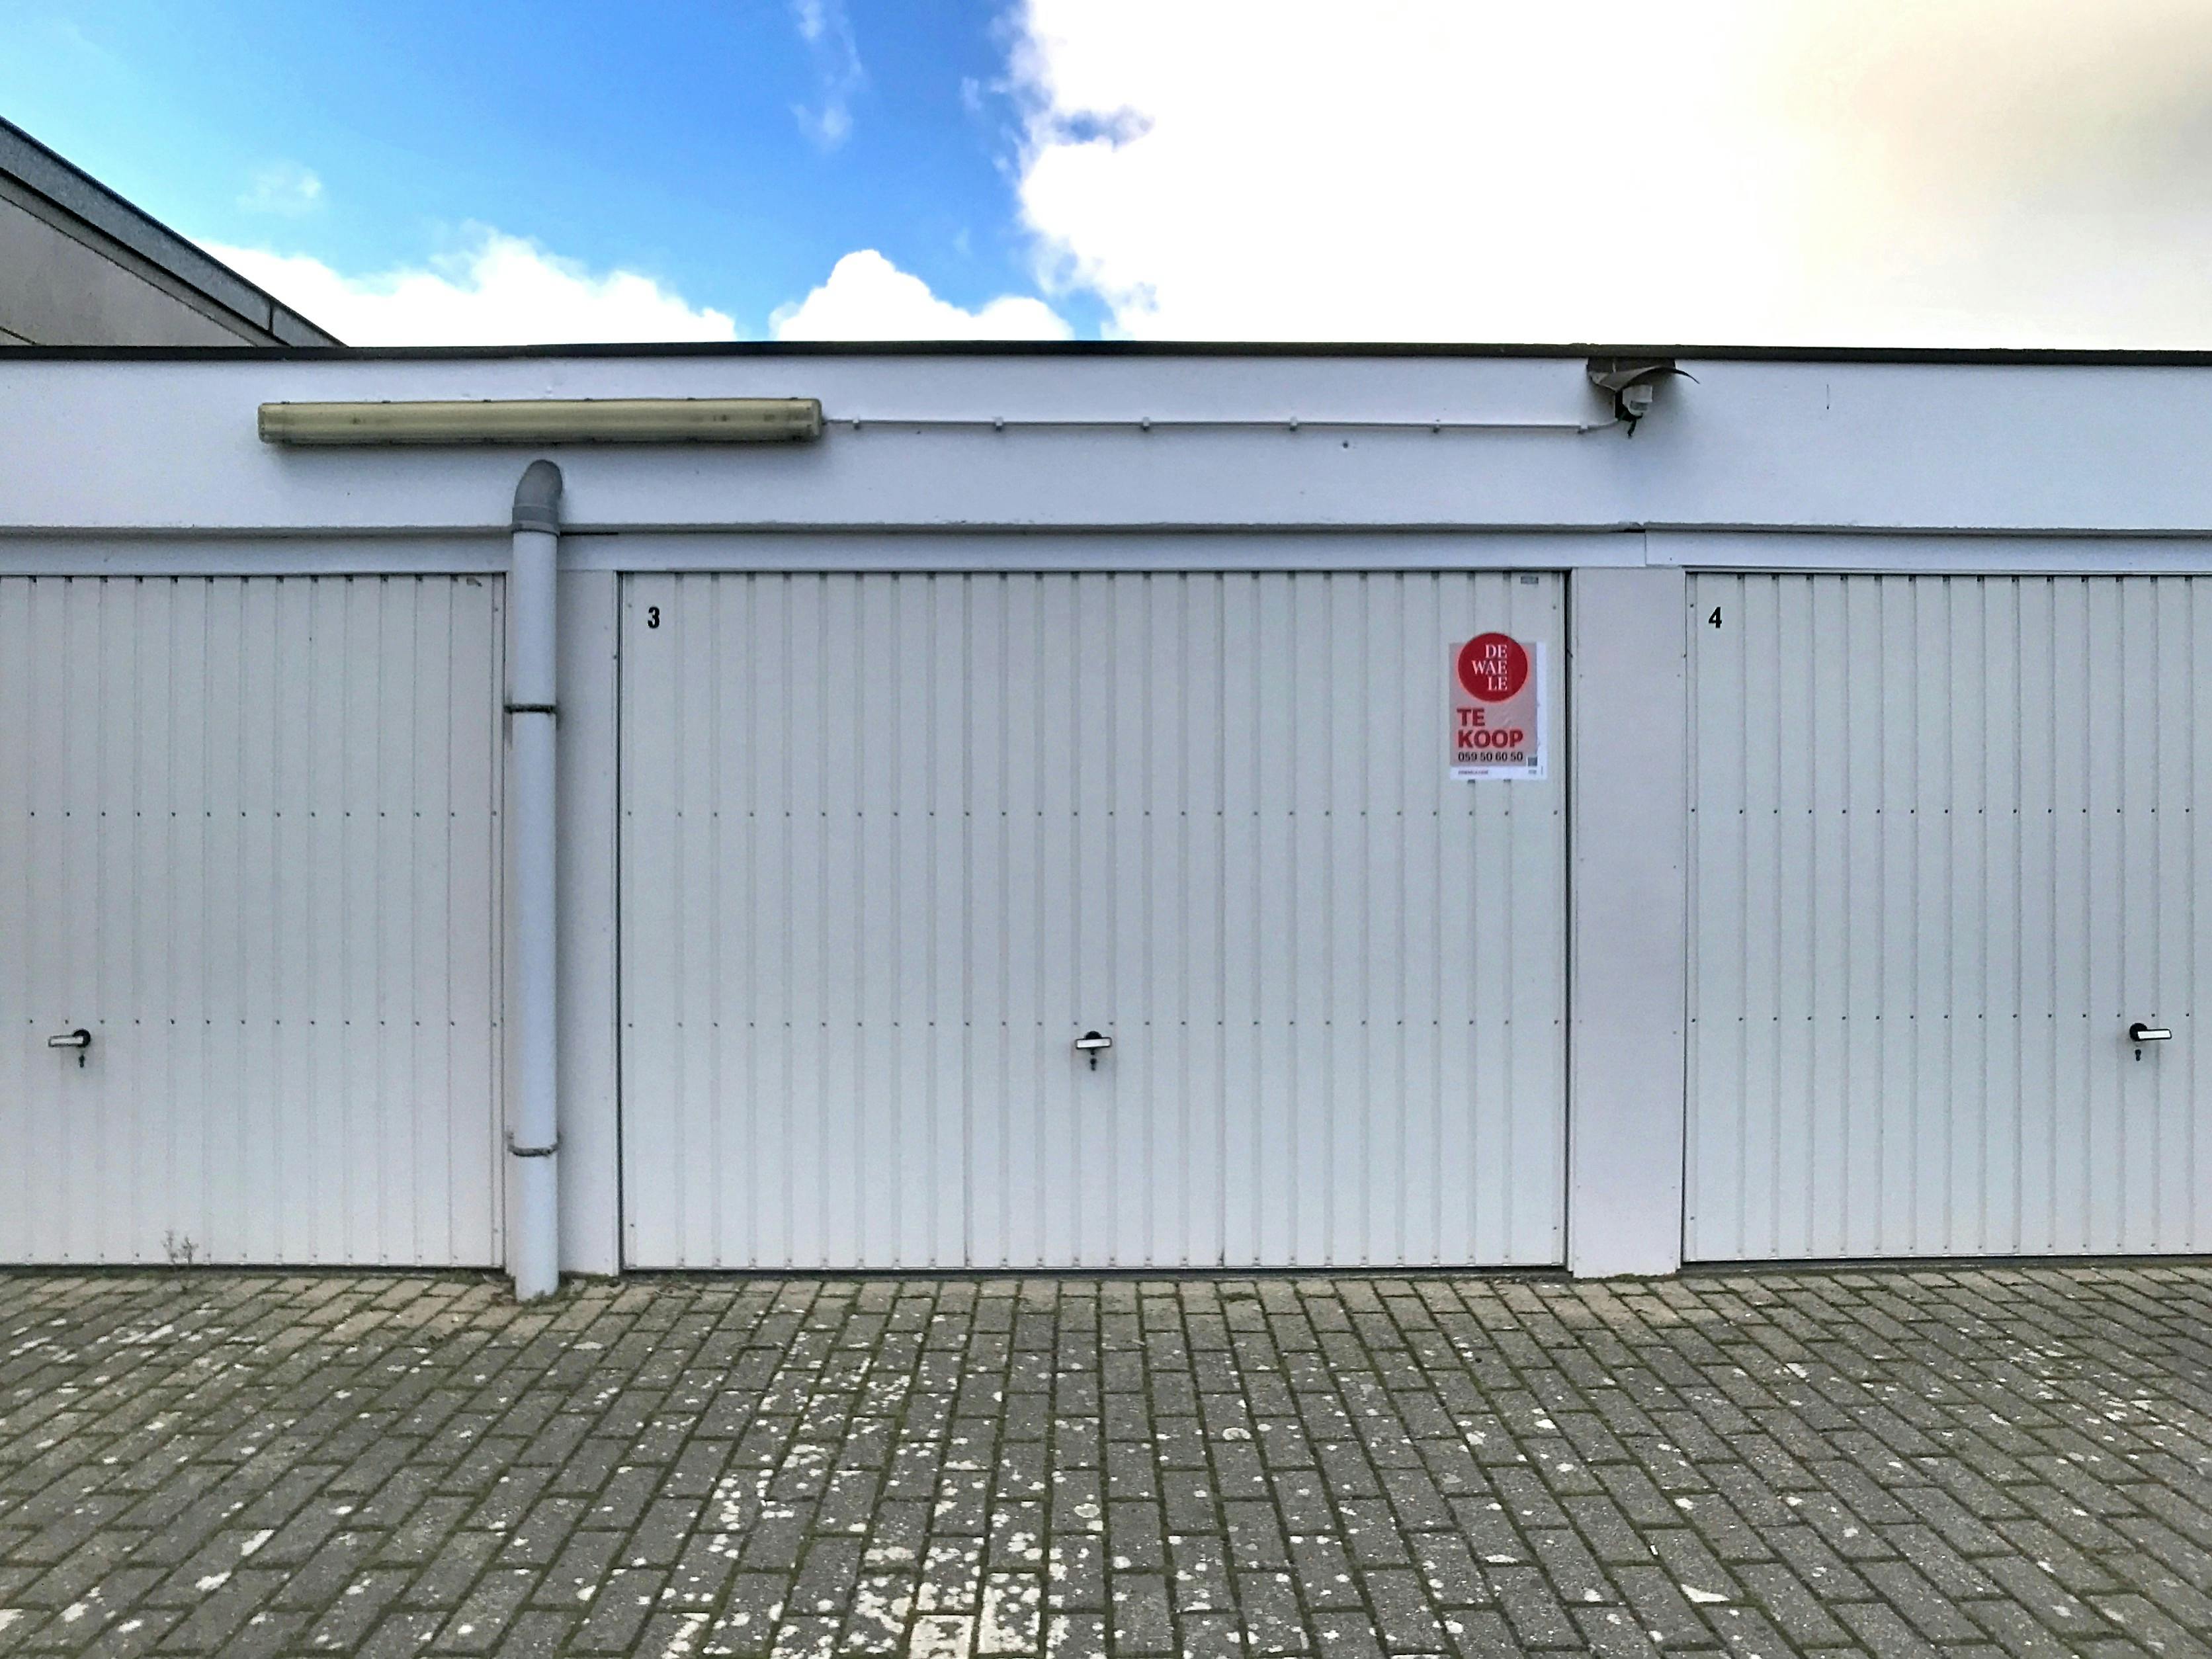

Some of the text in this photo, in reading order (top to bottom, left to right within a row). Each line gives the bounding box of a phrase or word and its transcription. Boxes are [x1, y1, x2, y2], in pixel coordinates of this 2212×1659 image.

[648, 607, 660, 628] 3
[1709, 607, 1723, 628] 4
[1485, 644, 1508, 658] DE
[1471, 660, 1508, 675] WAE
[1488, 676, 1508, 691] LE
[1457, 708, 1485, 726] TE
[1458, 730, 1523, 748] KOOP
[1458, 751, 1523, 761] 059 50 60 50
